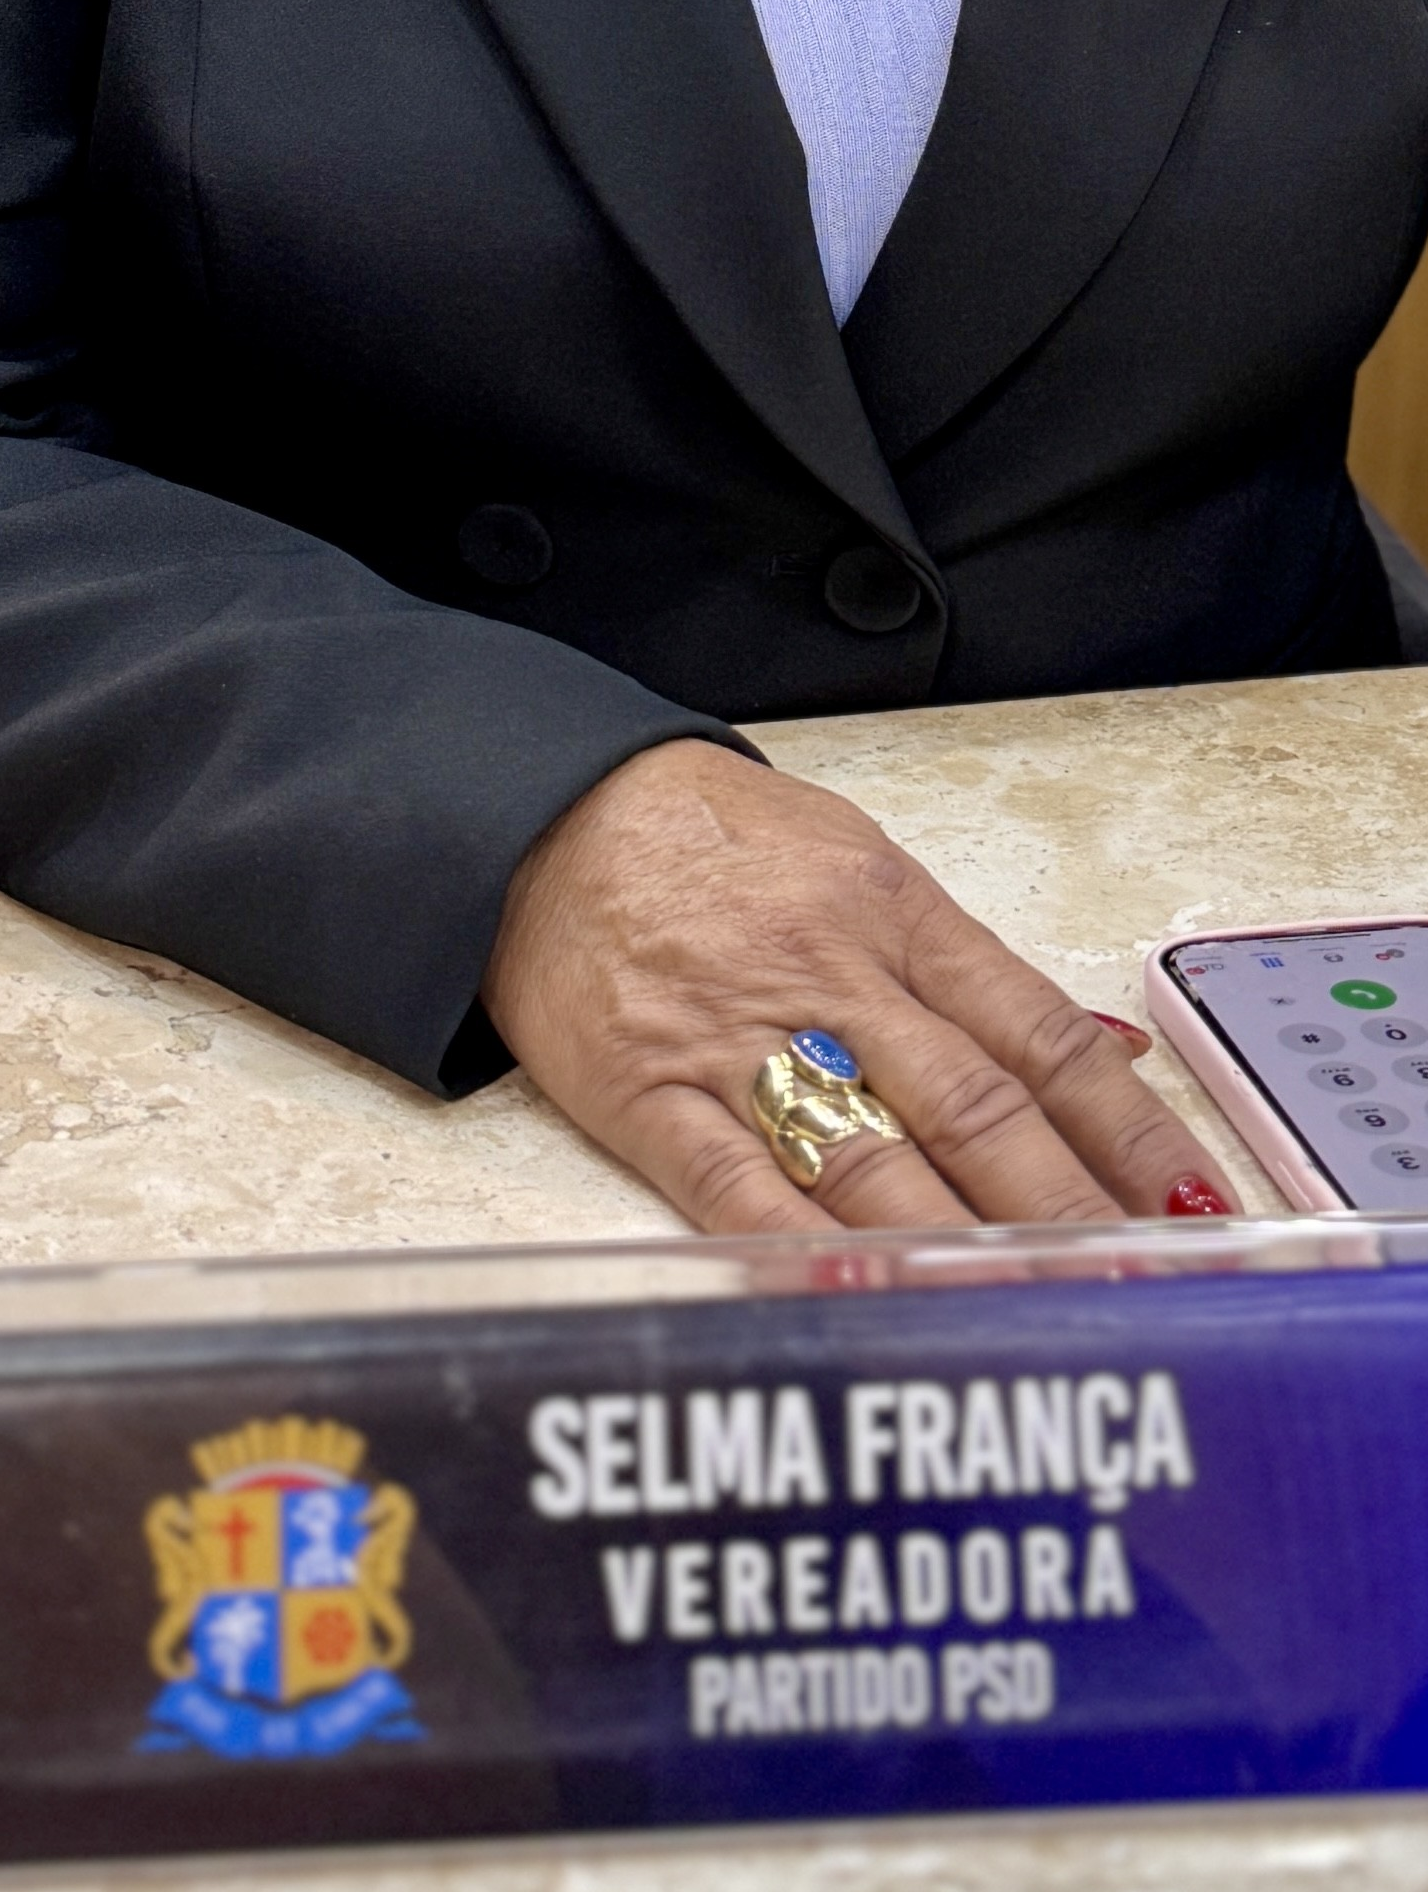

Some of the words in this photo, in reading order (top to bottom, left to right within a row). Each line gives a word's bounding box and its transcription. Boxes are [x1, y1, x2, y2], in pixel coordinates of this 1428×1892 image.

[1386, 1029, 1407, 1040] 0
[1333, 1074, 1354, 1086] 9
[1364, 1114, 1386, 1127] 6
[1397, 1156, 1420, 1170] 3
[529, 1387, 827, 1519] SELMA
[847, 1371, 1193, 1512] FRANÇA
[601, 1525, 1134, 1642] VEREADORA
[690, 1647, 930, 1737] PARTIDO
[941, 1639, 1055, 1724] PSD
